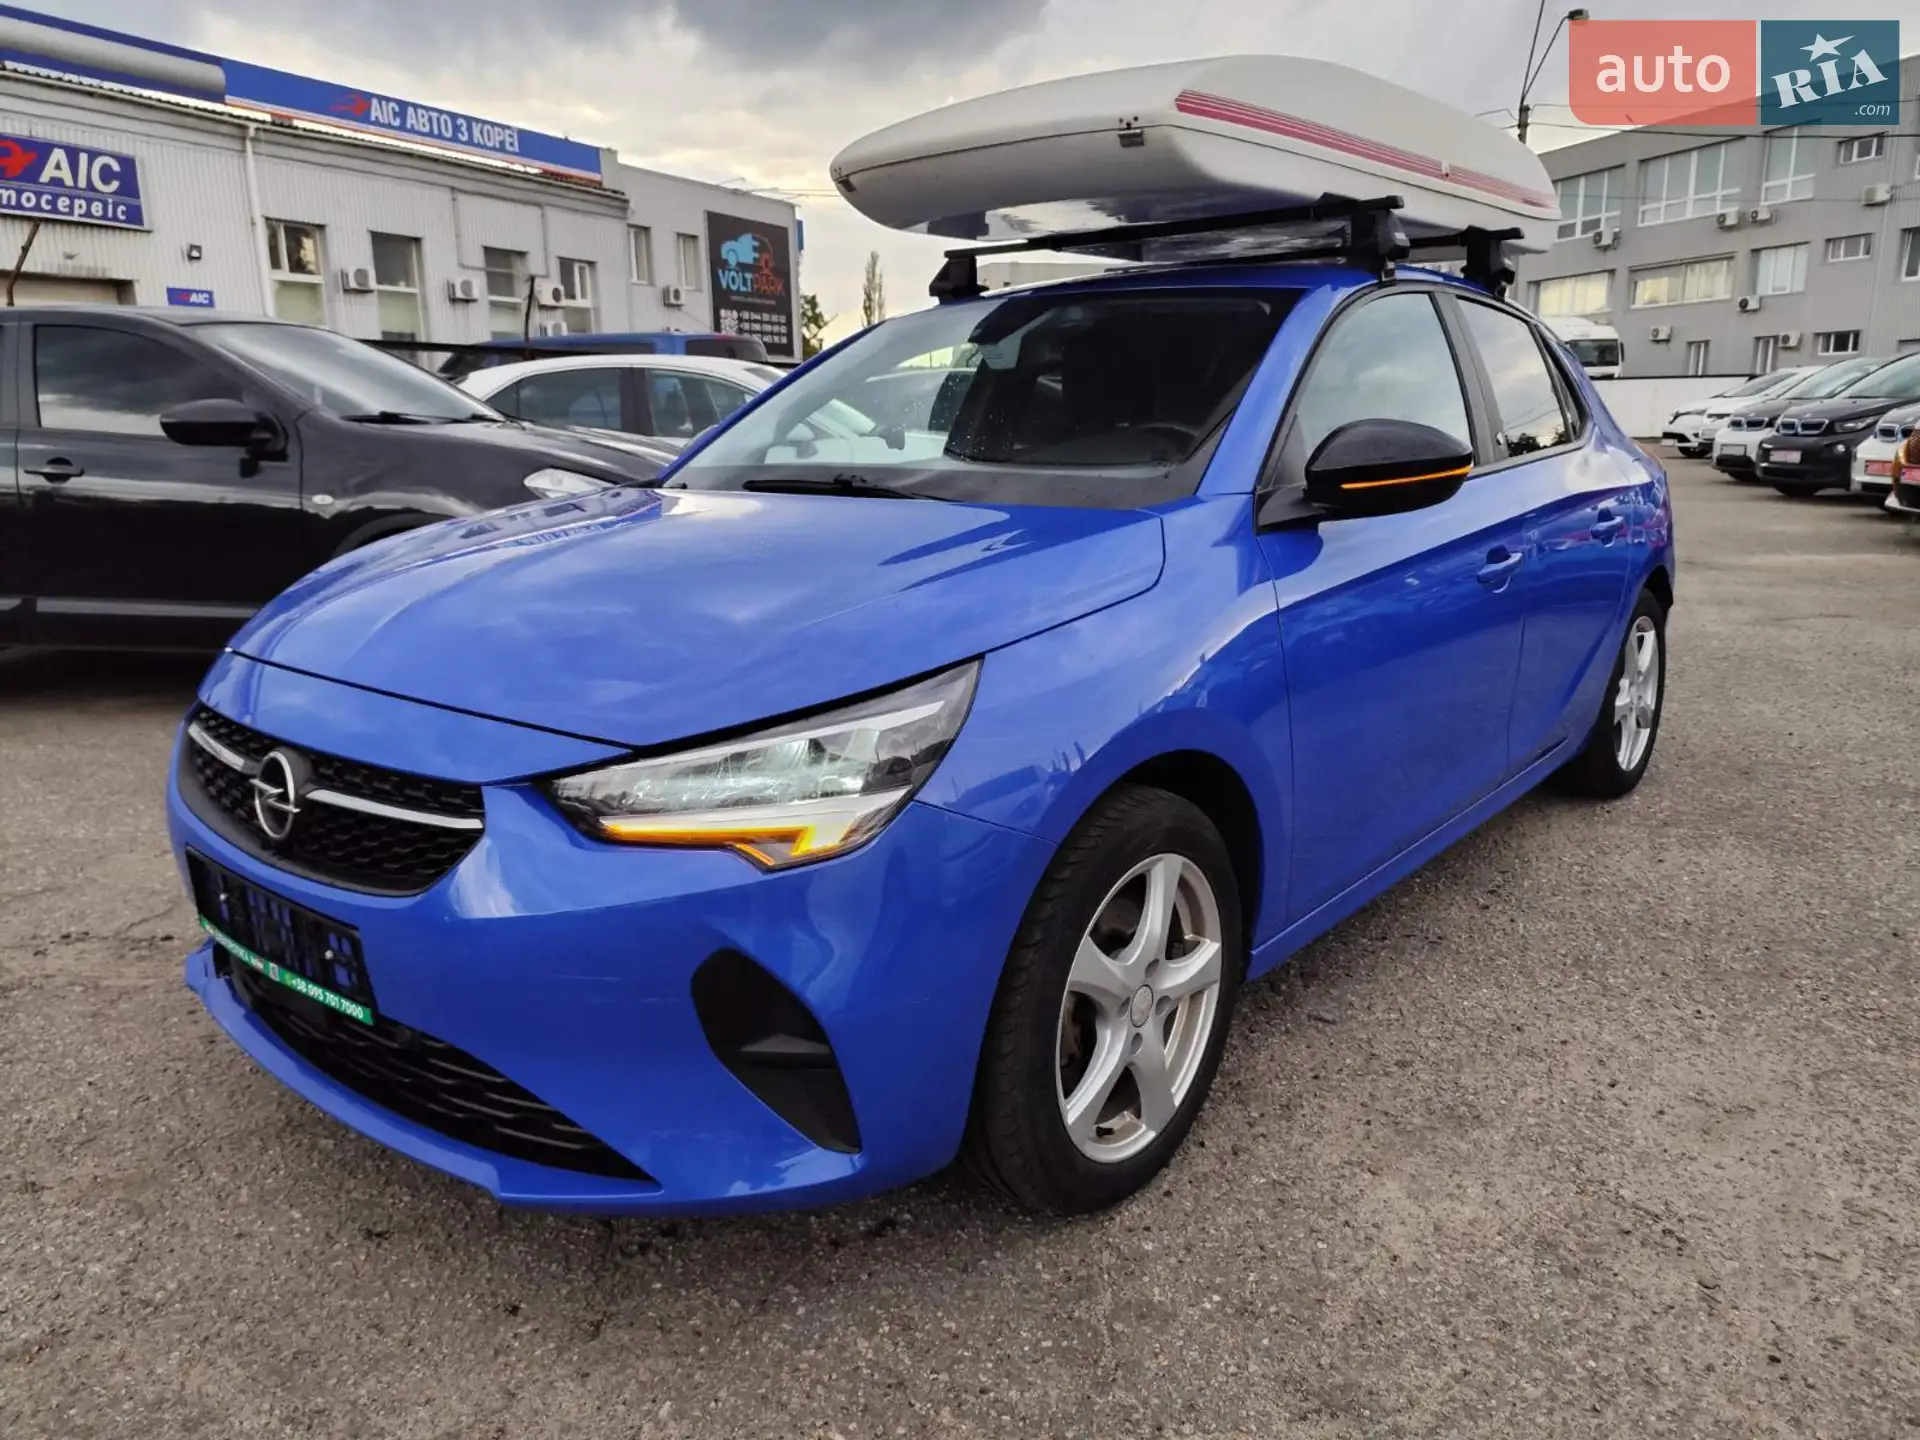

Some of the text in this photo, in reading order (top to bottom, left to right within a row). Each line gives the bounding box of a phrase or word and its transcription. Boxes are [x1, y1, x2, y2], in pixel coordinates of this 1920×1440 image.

[406, 106, 451, 138] АВТО
[472, 121, 520, 153] КОРЕЇ
[307, 983, 325, 1002] 095
[324, 991, 340, 1010] 701
[340, 998, 364, 1020] 7000
